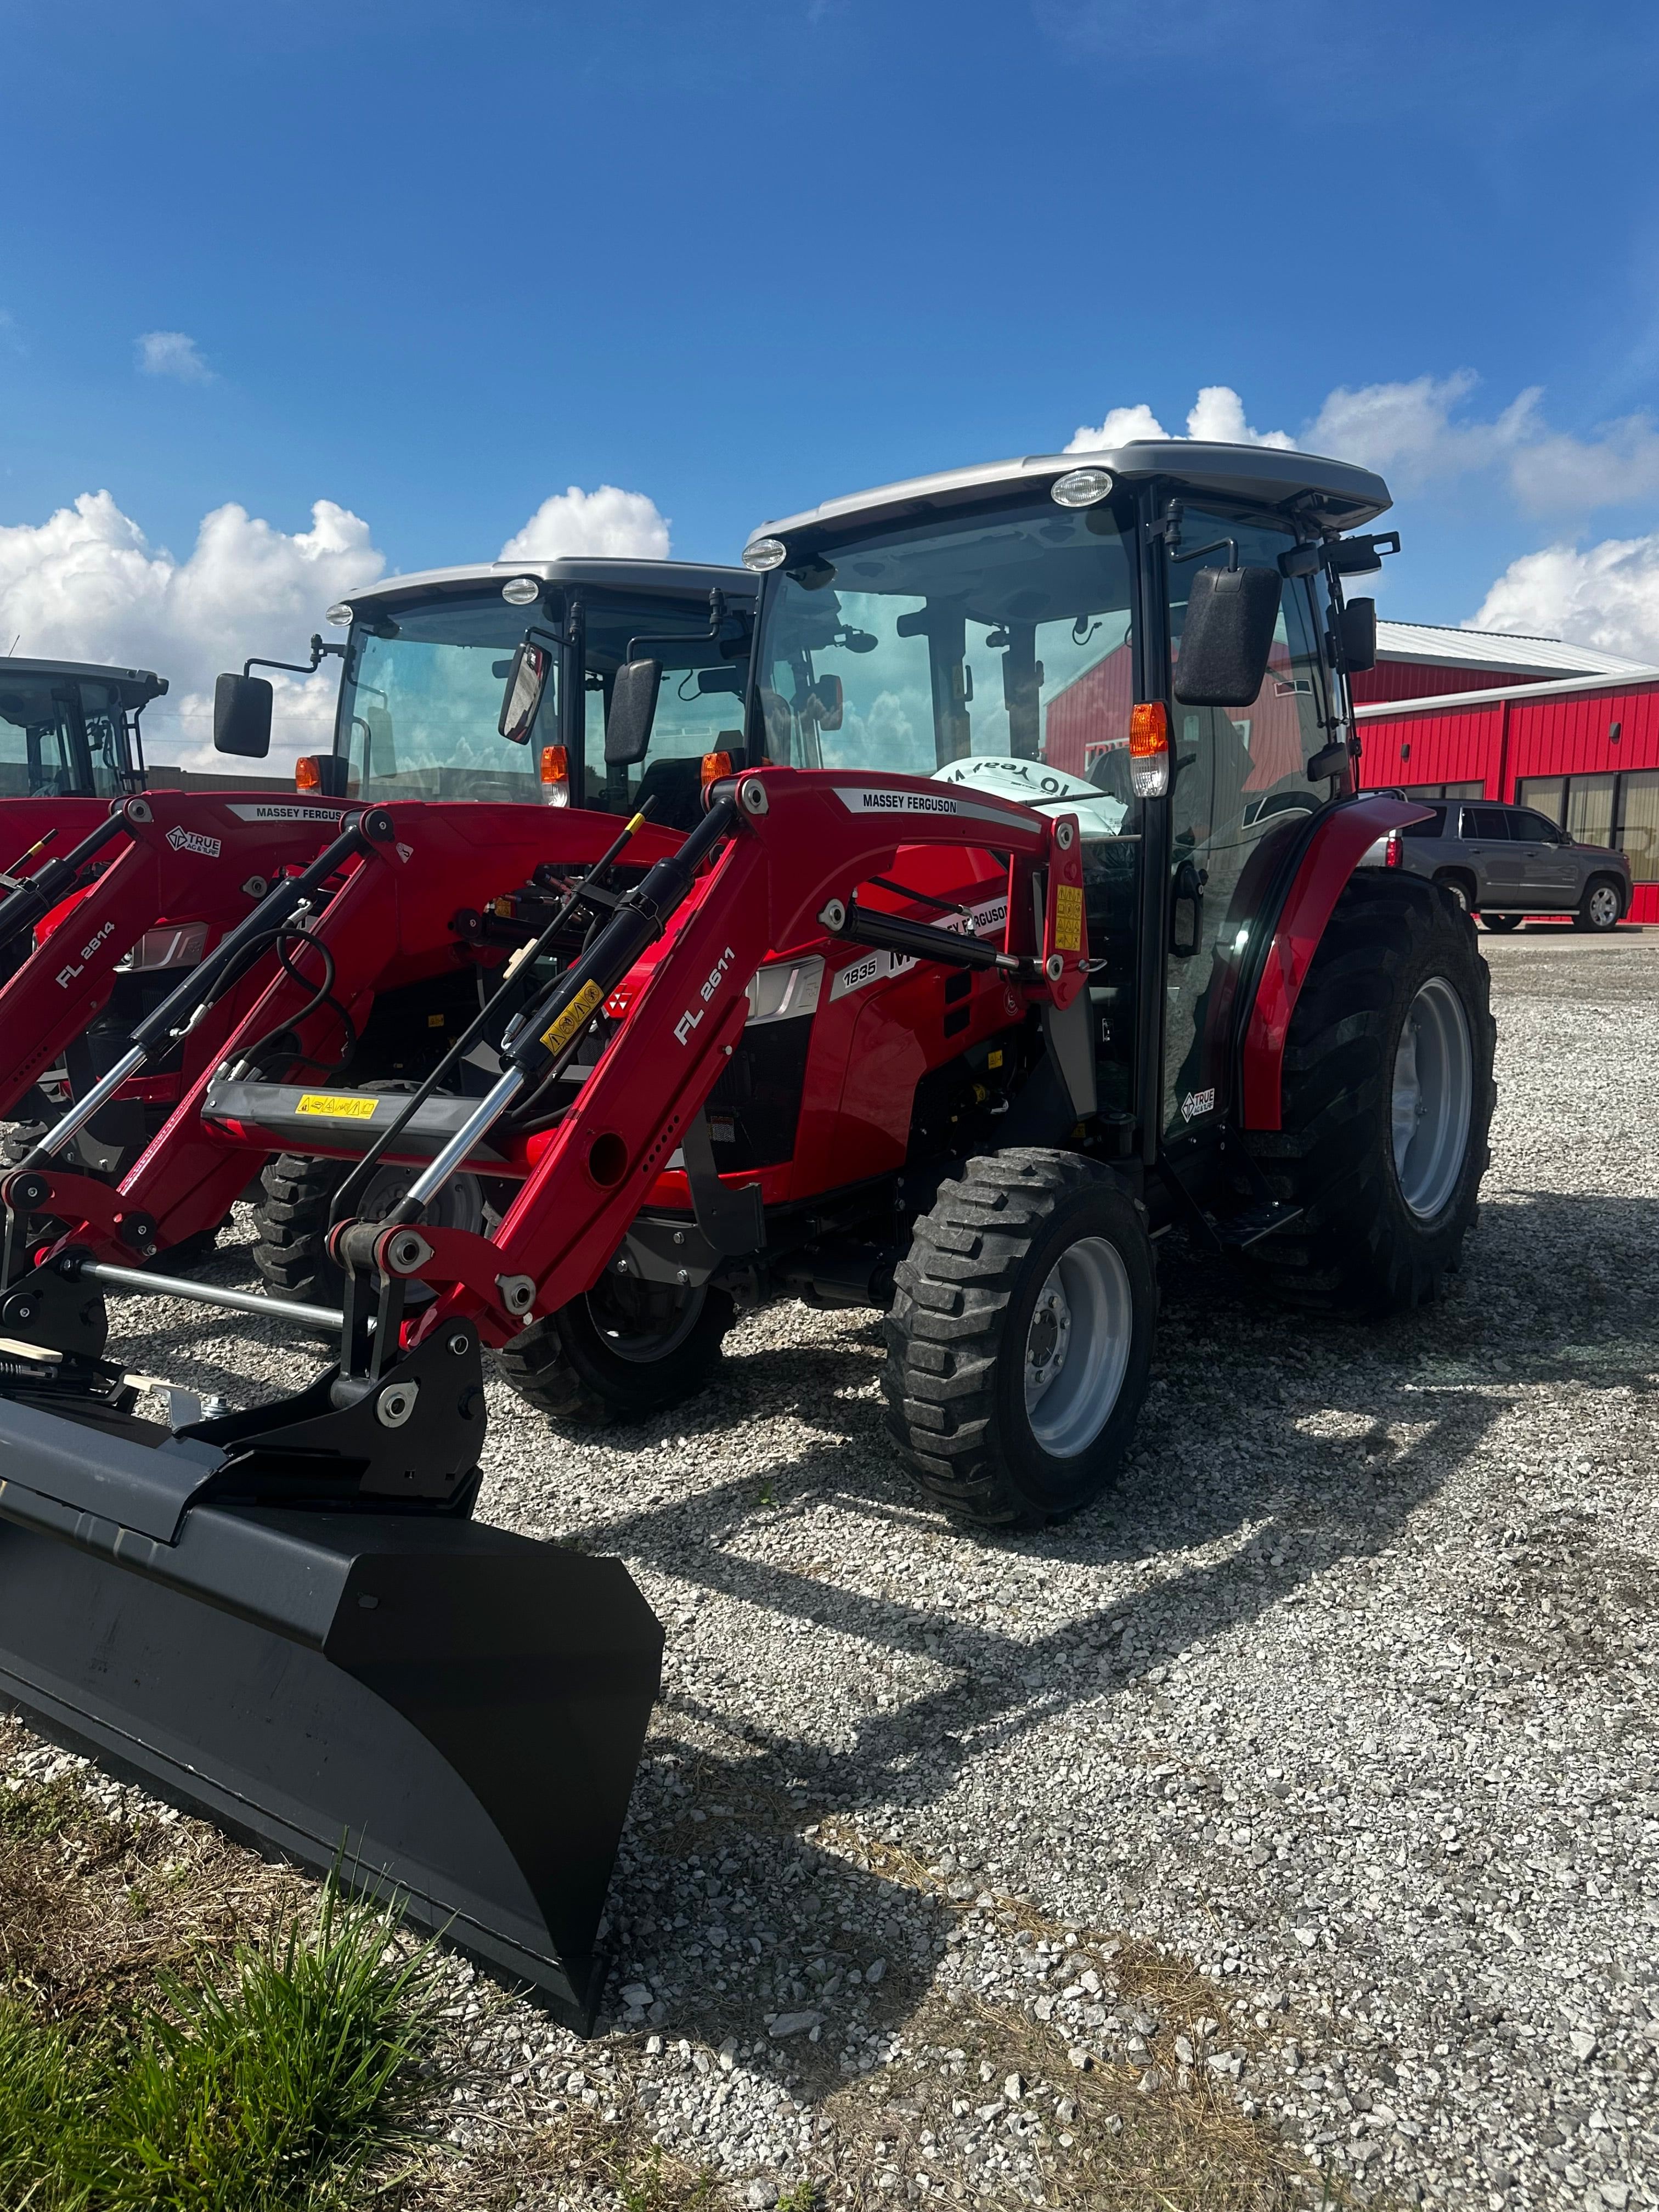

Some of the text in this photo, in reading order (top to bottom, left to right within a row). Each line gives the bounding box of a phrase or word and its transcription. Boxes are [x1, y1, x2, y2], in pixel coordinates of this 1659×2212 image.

[863, 794, 957, 813] MASSEY FERGUSON
[256, 808, 342, 820] MASSEY FERGUS
[188, 833, 220, 850] TRUE
[202, 847, 219, 856] TURF
[962, 905, 1008, 933] FRGUSO
[55, 921, 115, 989] FL 2814
[843, 960, 876, 986] 1835
[673, 946, 735, 1046] FL 2611
[1195, 1090, 1214, 1107] TRUE
[1194, 1105, 1200, 1114] AG
